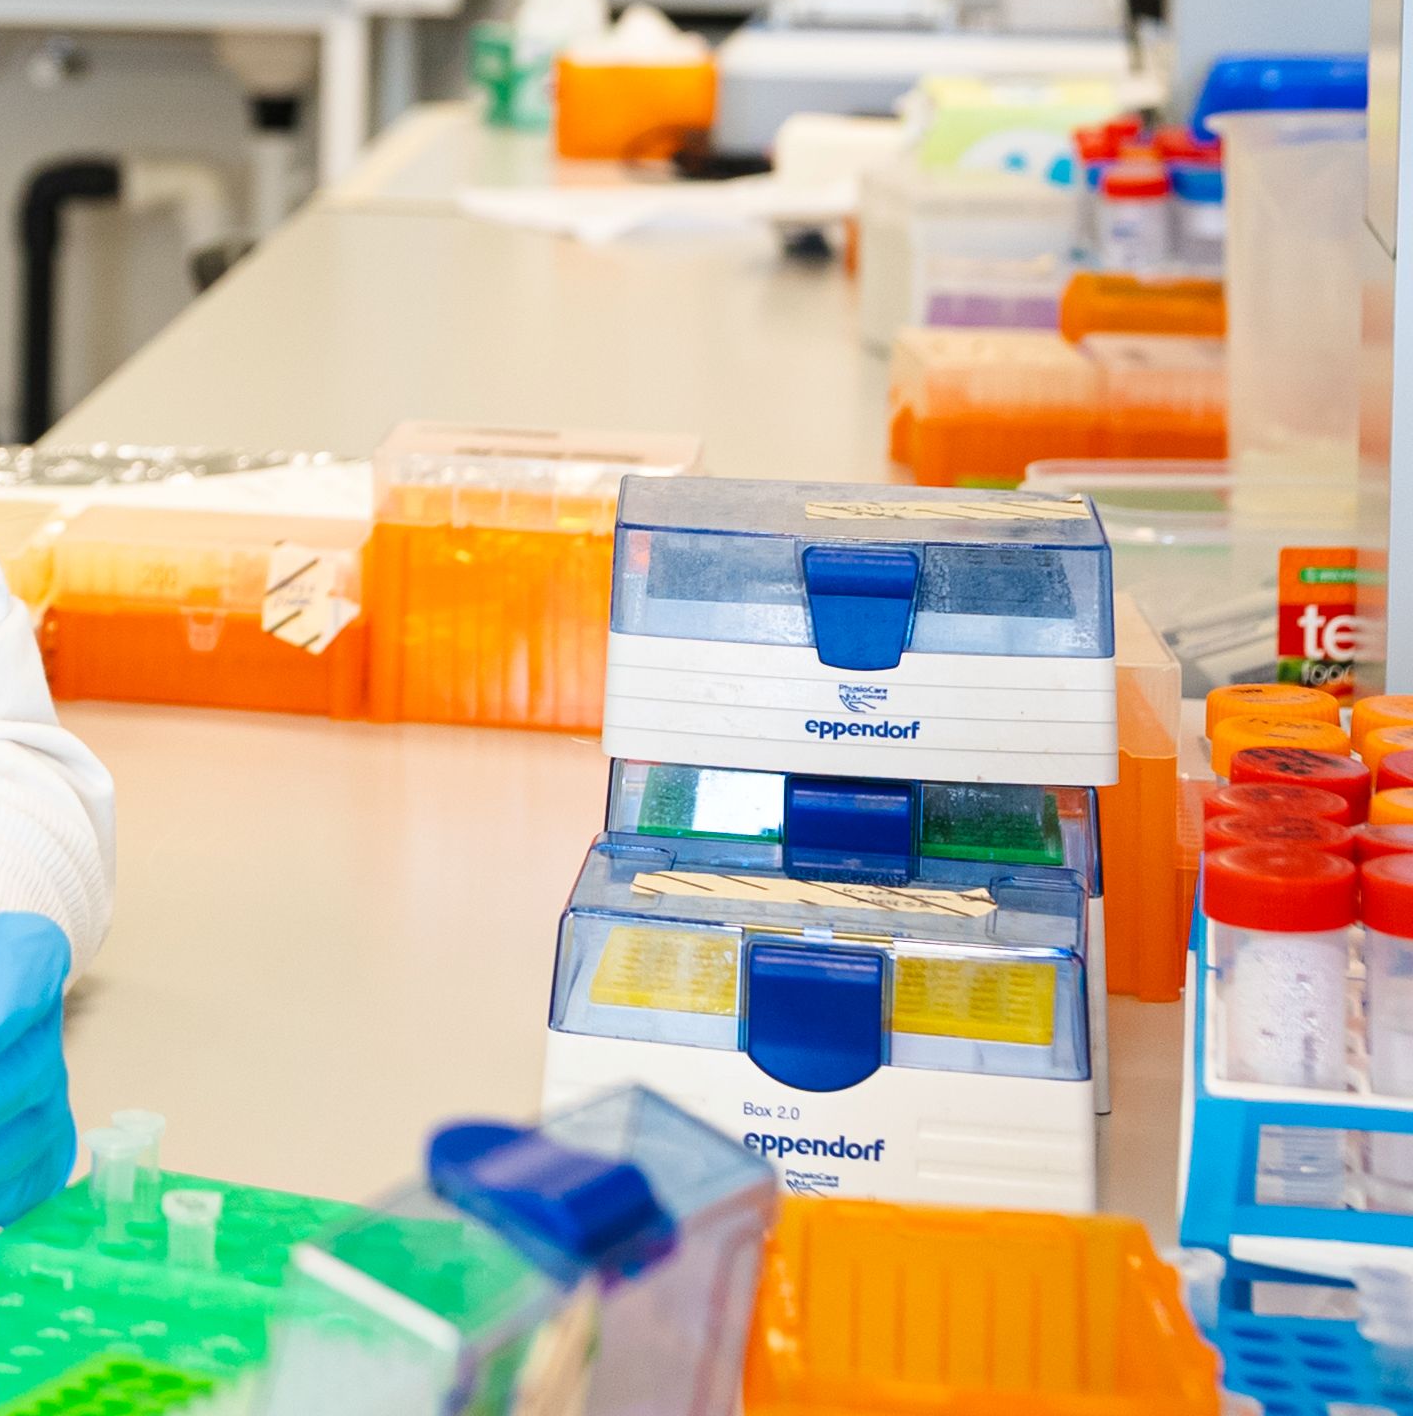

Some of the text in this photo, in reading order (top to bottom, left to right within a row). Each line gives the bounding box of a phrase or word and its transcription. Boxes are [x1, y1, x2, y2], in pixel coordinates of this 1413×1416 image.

[805, 719, 920, 740] eppendorf
[743, 1101, 801, 1121] Box 2.0
[743, 1132, 885, 1162] eppendorf
